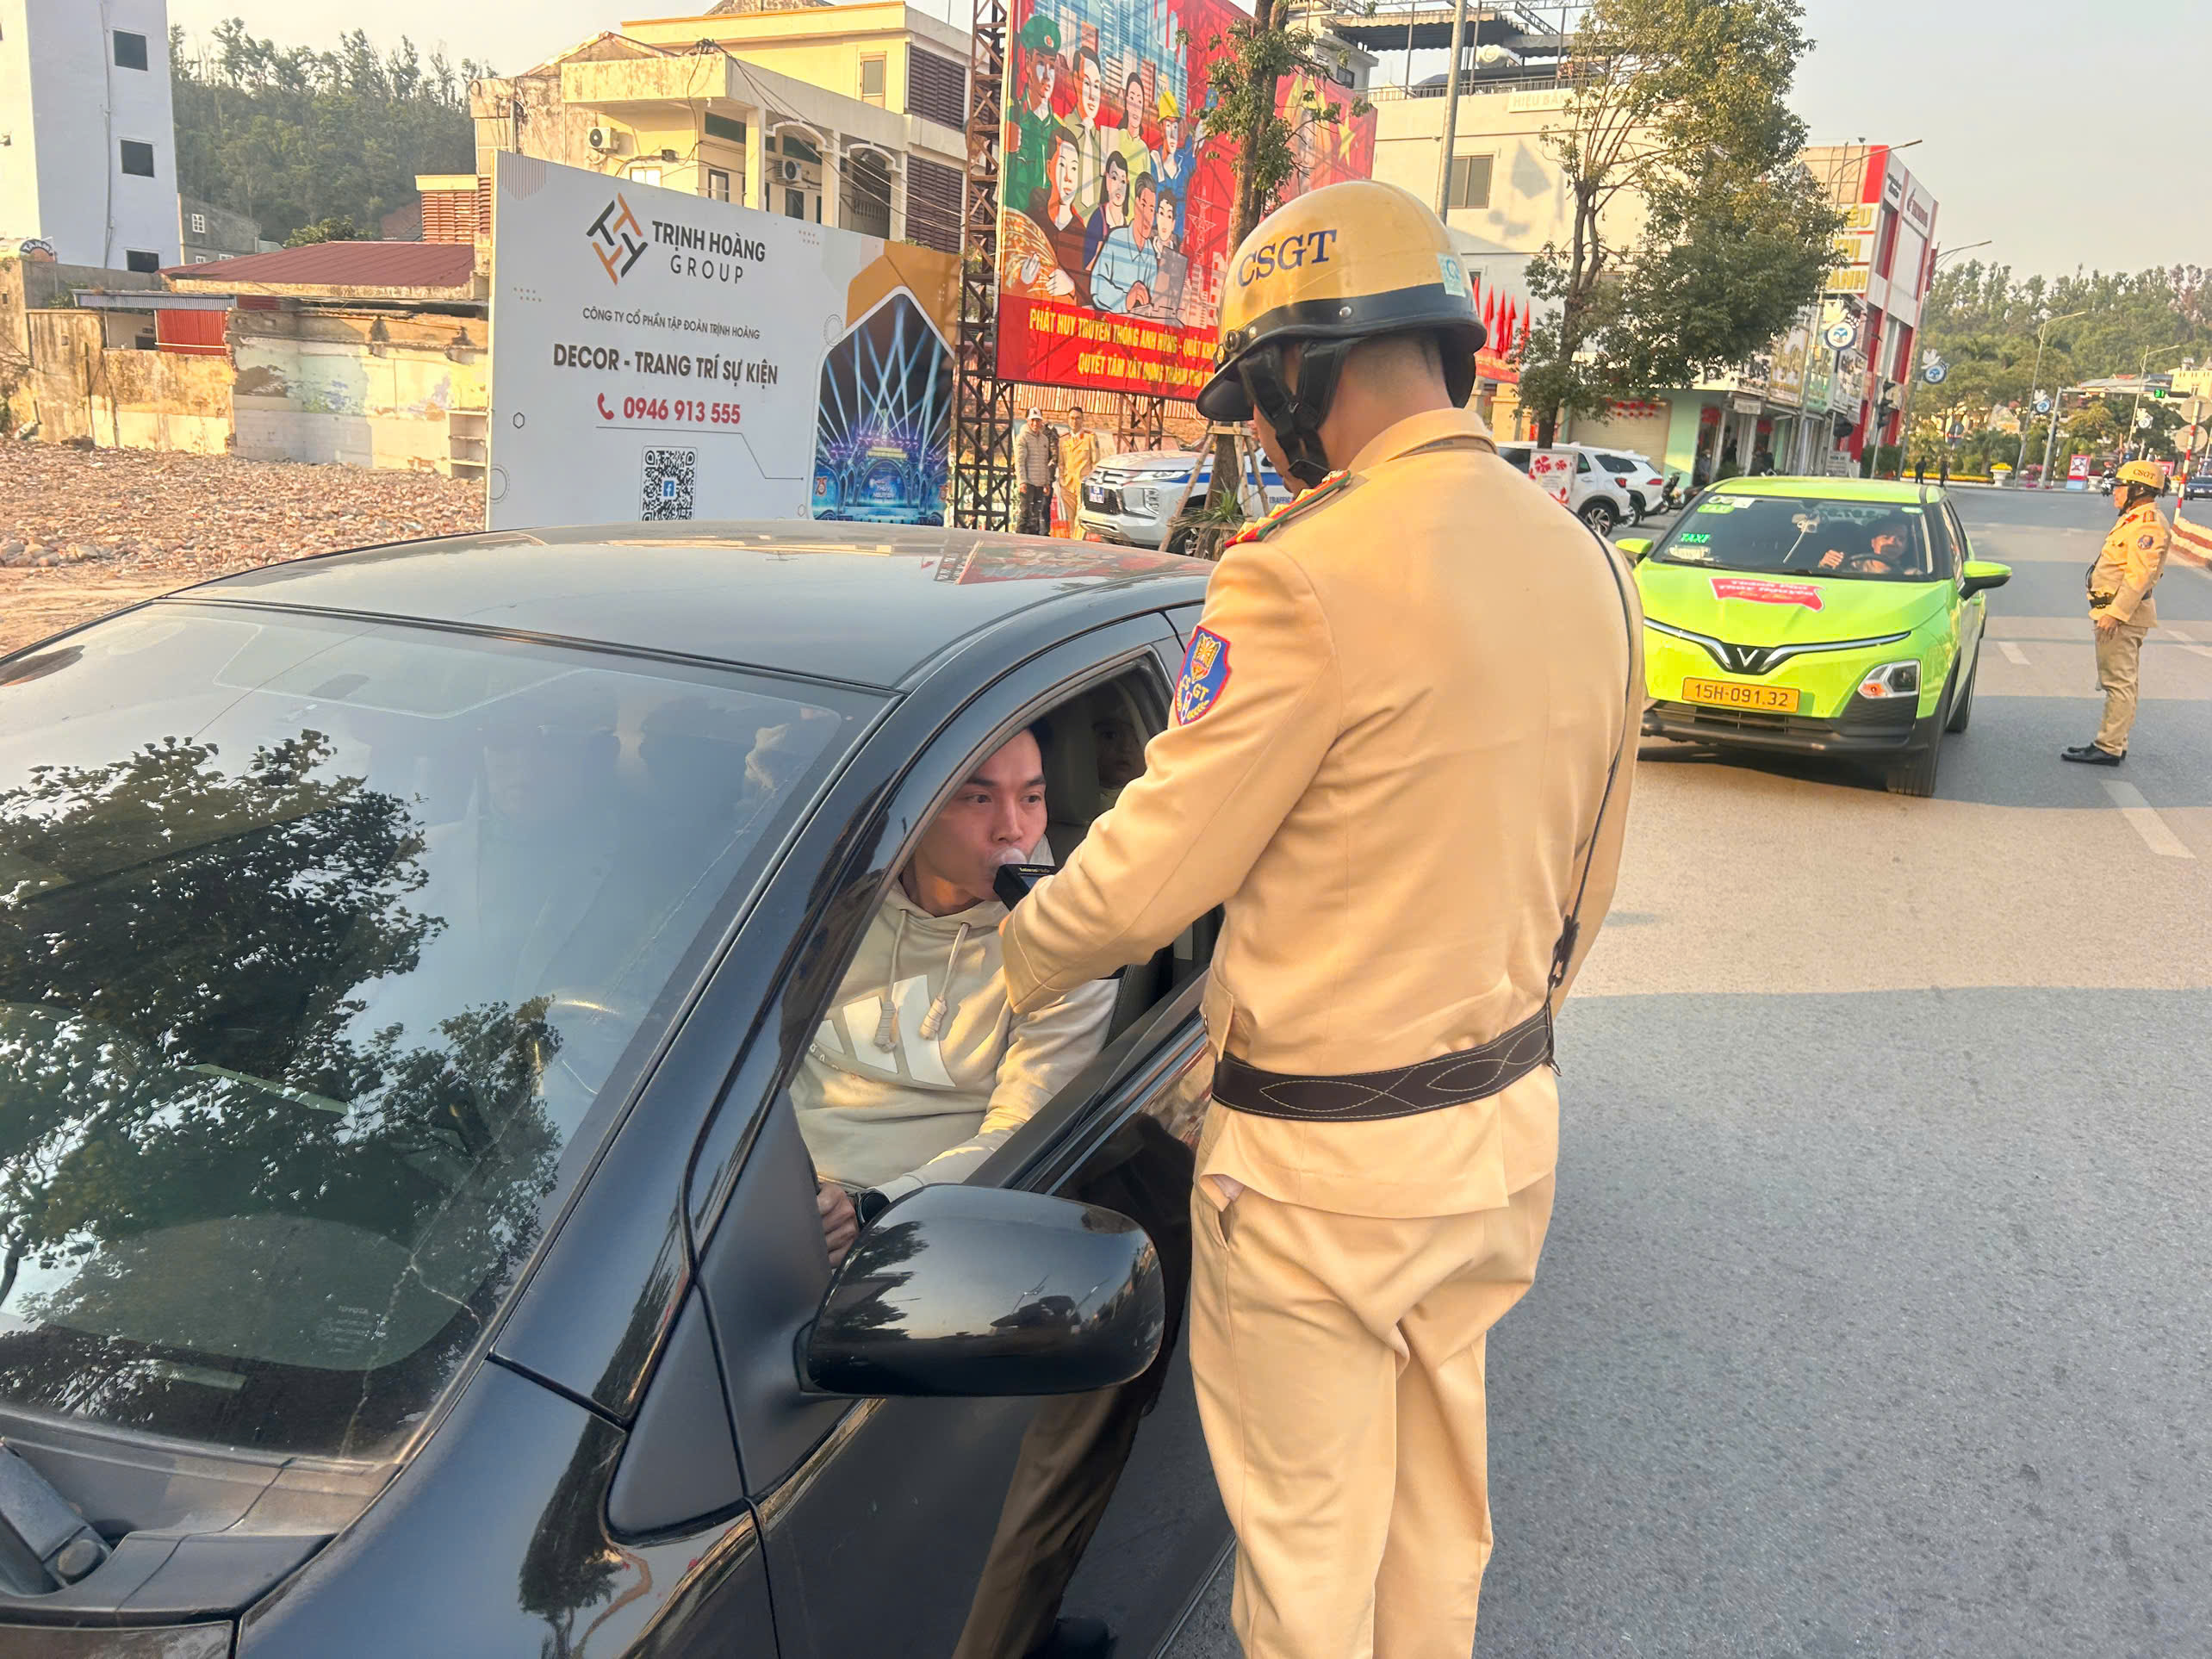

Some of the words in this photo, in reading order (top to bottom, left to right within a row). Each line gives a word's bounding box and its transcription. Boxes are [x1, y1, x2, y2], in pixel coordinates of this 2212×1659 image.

[652, 220, 705, 251] TRỊNH
[709, 233, 766, 262] HOÀNG
[670, 254, 743, 283] GROUP
[1238, 228, 1337, 287] CSGT
[582, 306, 612, 321] CÔNG
[614, 311, 624, 322] TY
[683, 319, 708, 332] ĐOÀN
[731, 325, 760, 339] HOÀNG
[1028, 307, 1056, 333] PHÁT
[1057, 314, 1076, 336] HUY
[1140, 329, 1158, 351] ANH
[554, 343, 619, 370] DECOR
[635, 351, 692, 376] TRANG
[696, 353, 719, 380] TRÍ
[723, 358, 743, 387] SỰ
[746, 358, 778, 389] KIỆN
[624, 396, 668, 420] 0946
[674, 400, 705, 422] 913
[711, 402, 741, 424] 555
[2133, 469, 2156, 480] CSGT
[1681, 532, 1712, 544] TAXI
[1694, 683, 1789, 706] 15H-091.32
